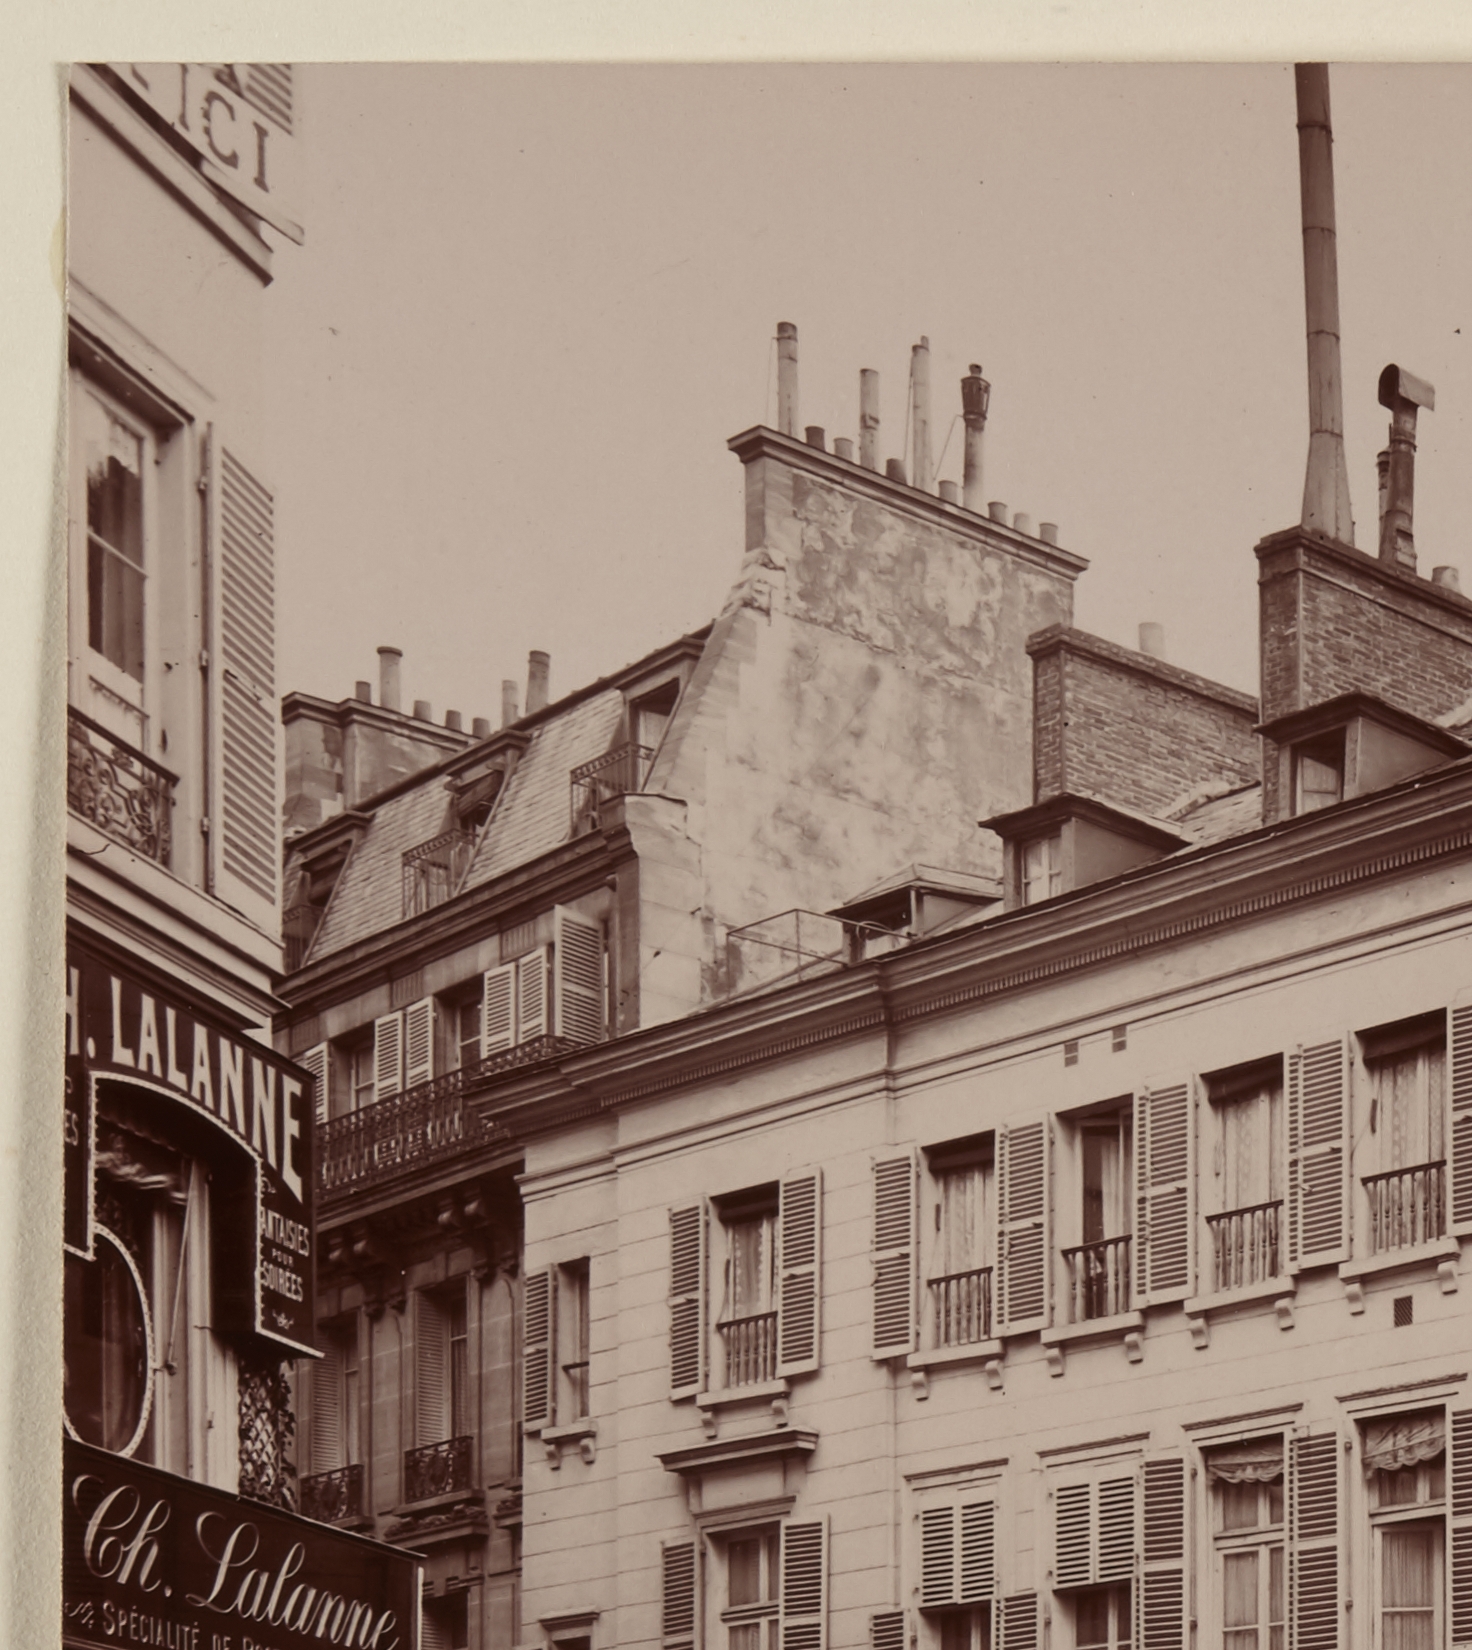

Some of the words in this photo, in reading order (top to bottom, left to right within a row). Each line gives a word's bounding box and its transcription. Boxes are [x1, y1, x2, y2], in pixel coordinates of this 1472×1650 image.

[110, 975, 304, 1204] LALANNE
[272, 1248, 294, 1268] POUR
[71, 1473, 173, 1598] Ch.
